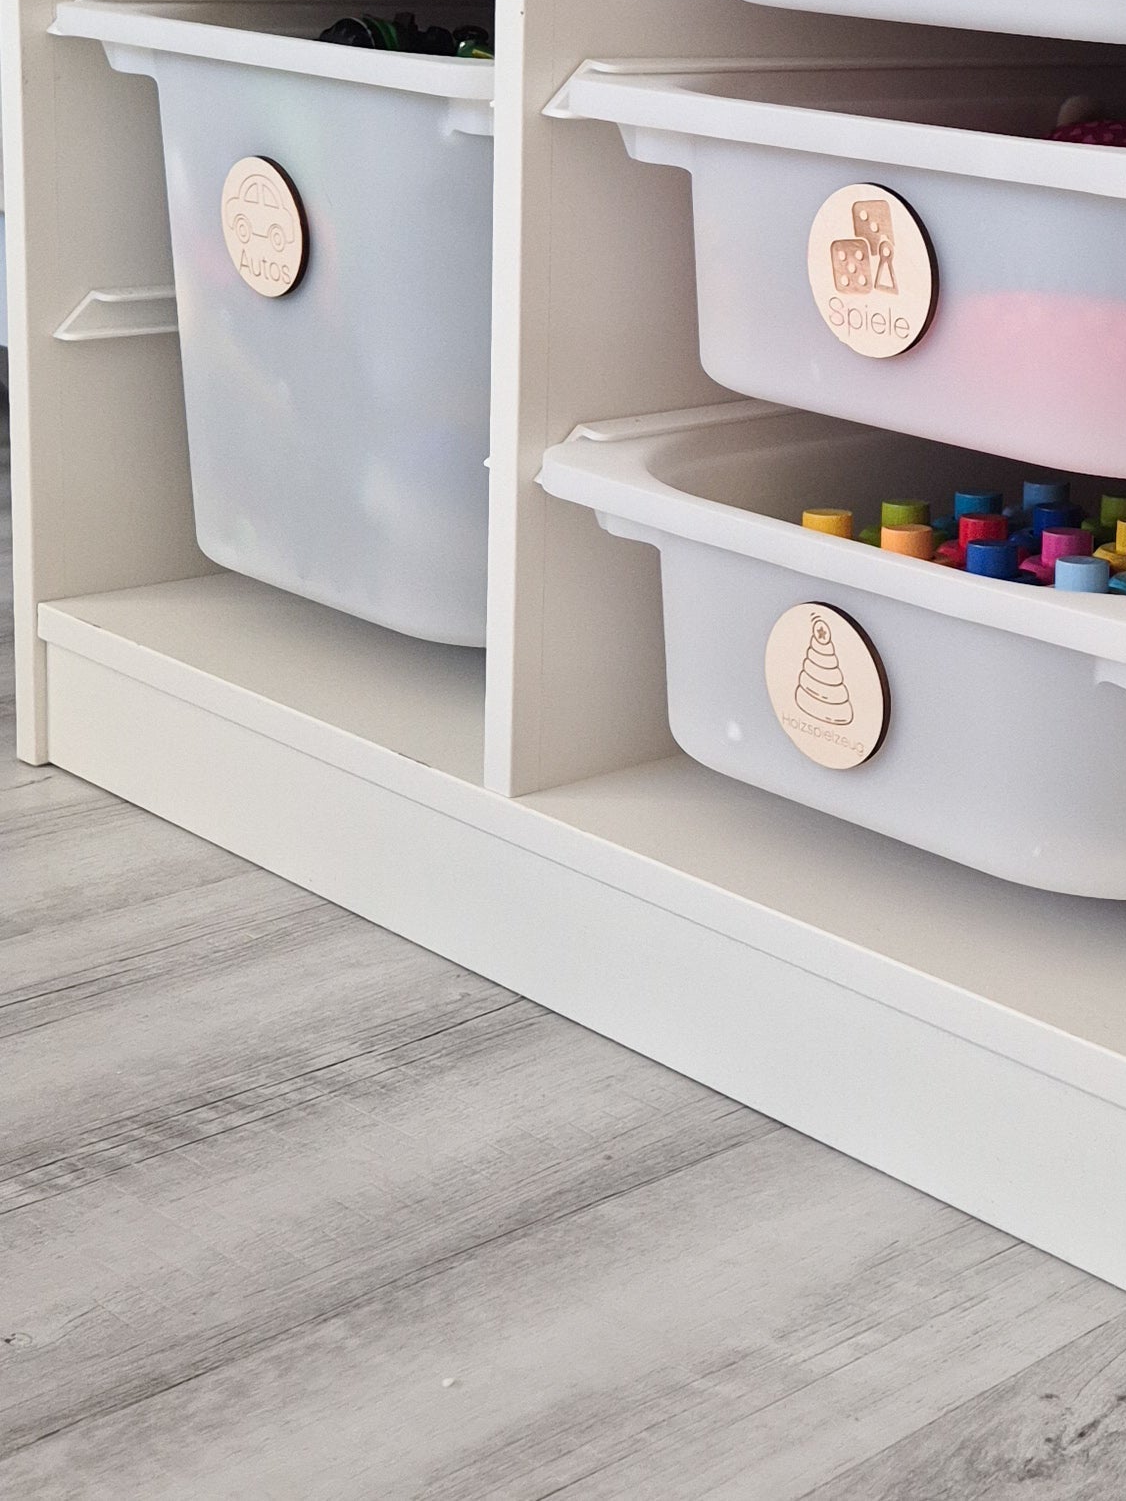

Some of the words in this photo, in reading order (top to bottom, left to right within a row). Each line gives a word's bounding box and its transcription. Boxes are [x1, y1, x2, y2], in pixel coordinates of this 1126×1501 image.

[239, 249, 292, 285] Autos
[828, 296, 910, 339] Spiele
[781, 713, 865, 757] Holzspielzeug
